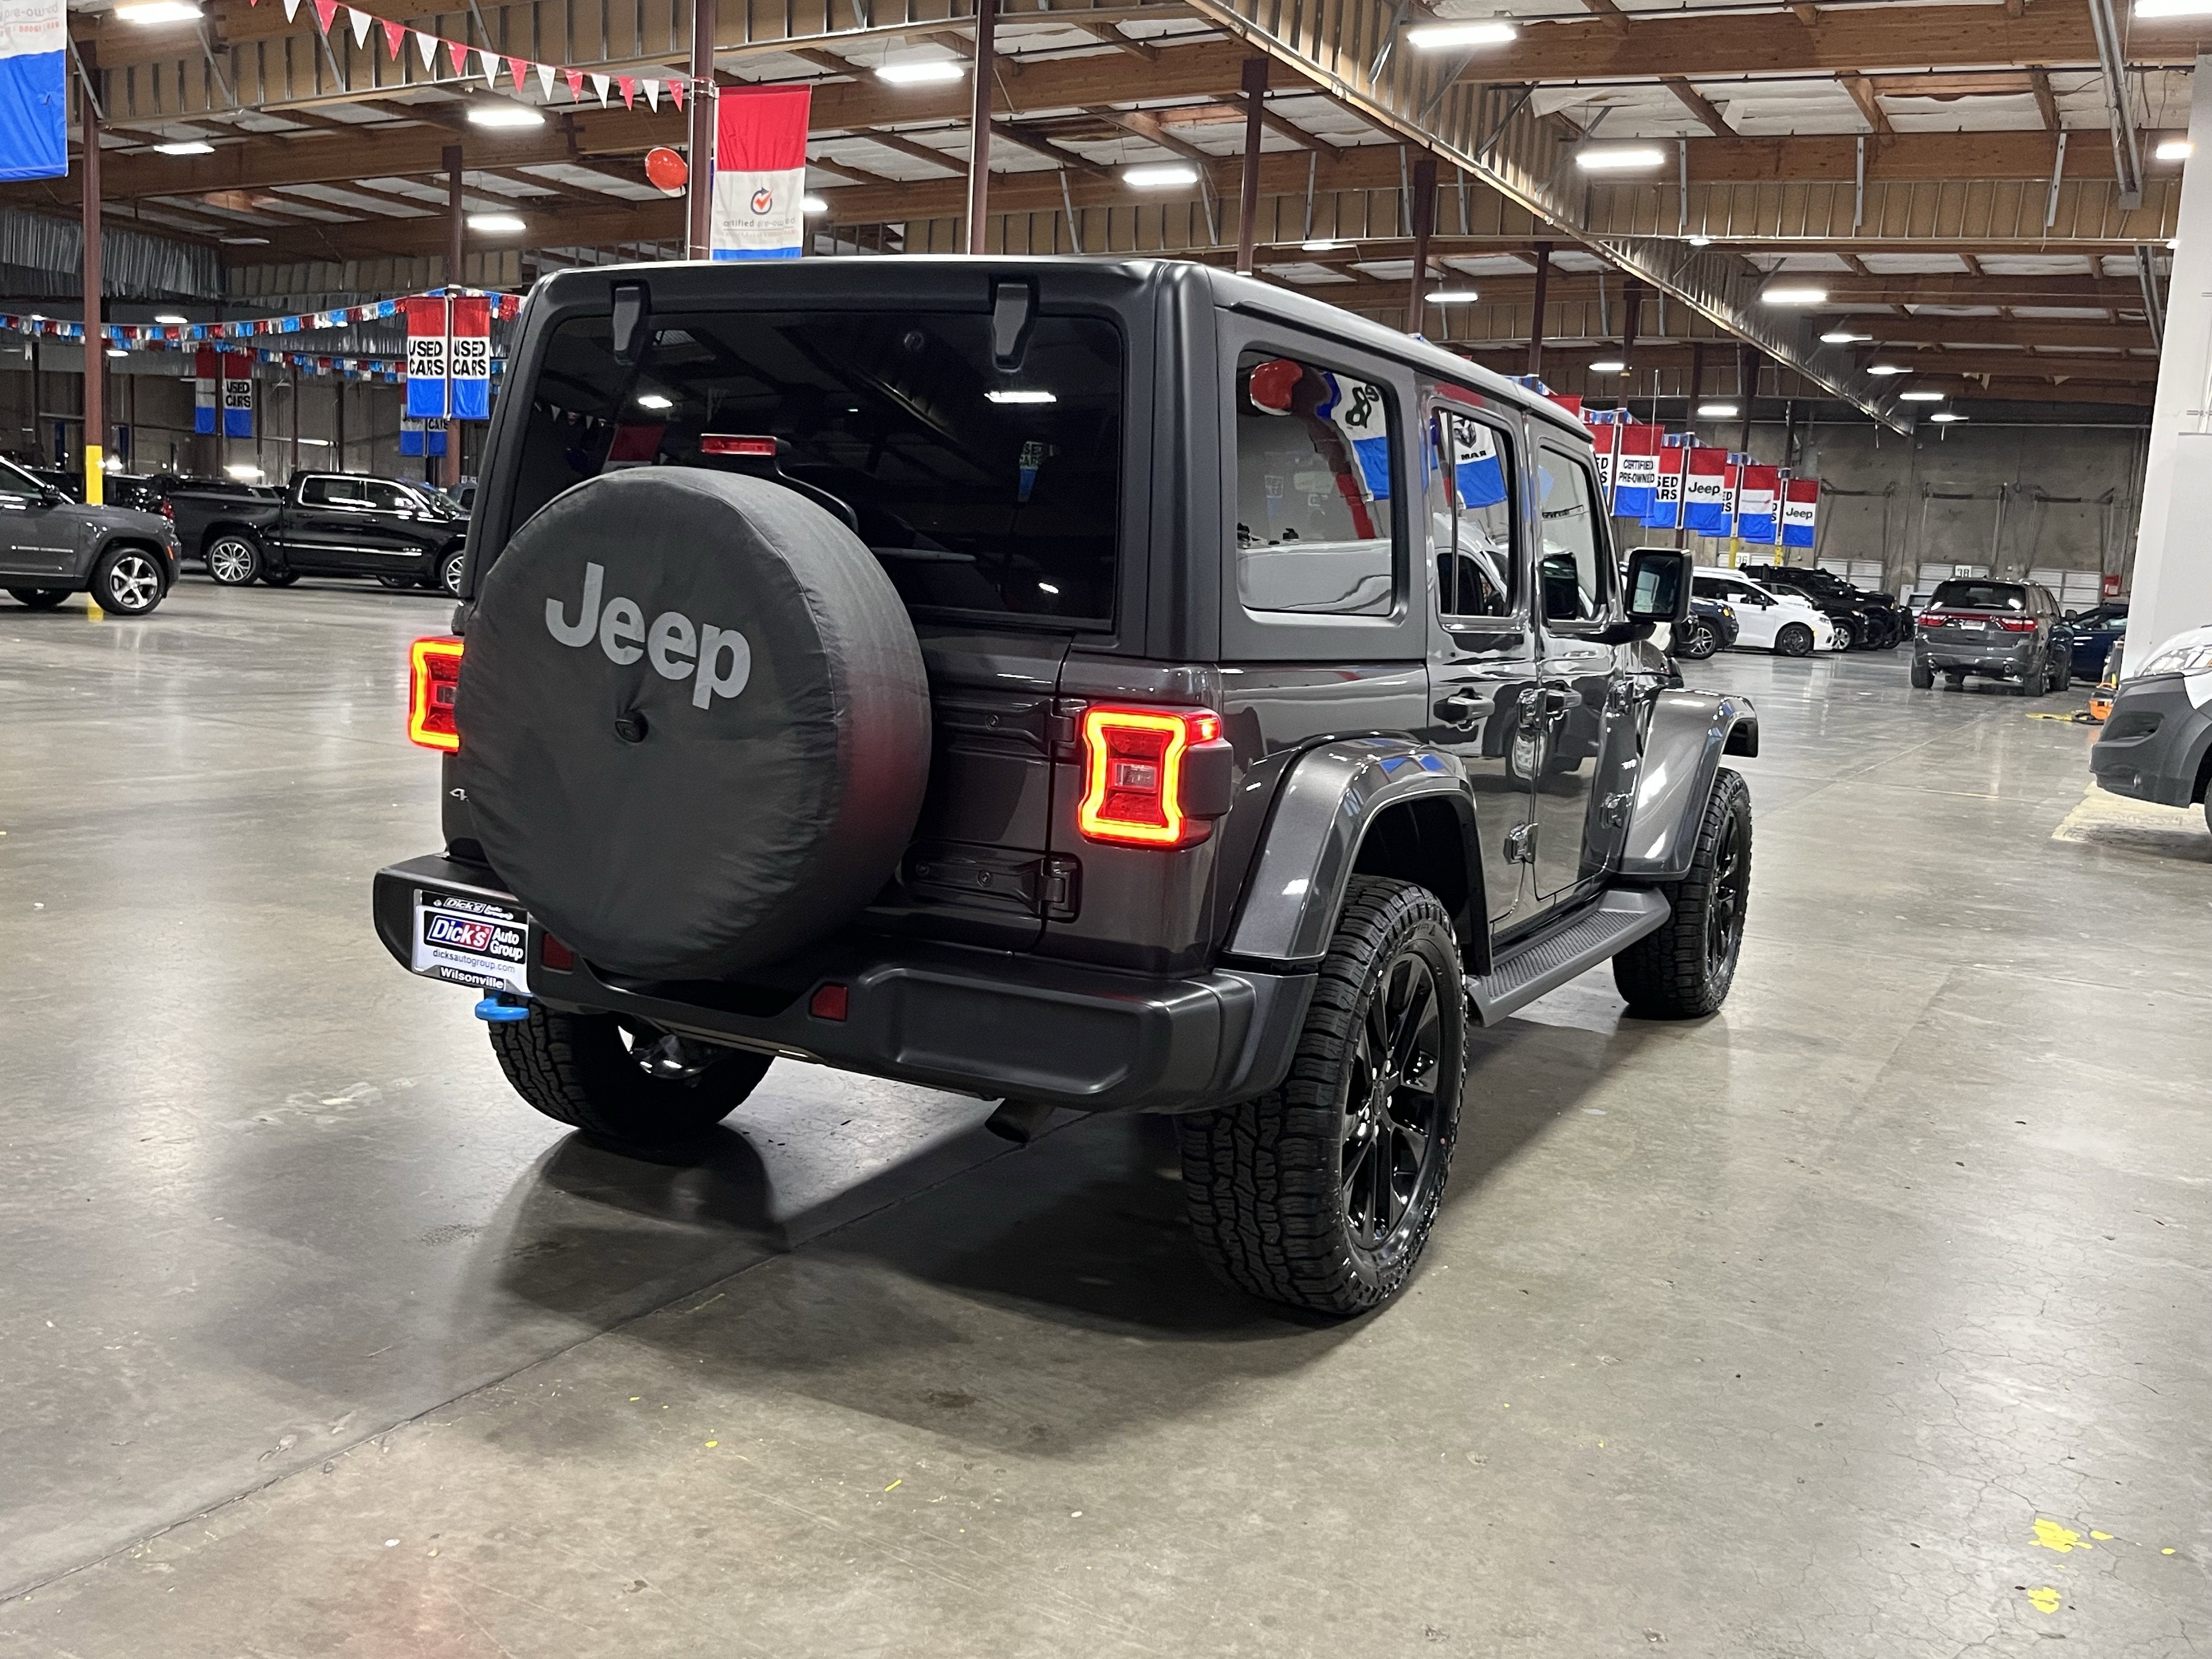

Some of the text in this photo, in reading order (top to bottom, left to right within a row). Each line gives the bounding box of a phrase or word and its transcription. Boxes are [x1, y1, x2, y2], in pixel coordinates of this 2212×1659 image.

[4, 1, 58, 19] pre-owed
[758, 217, 795, 227] pre-owed
[409, 340, 443, 357] USED
[454, 340, 486, 357] USED
[409, 359, 444, 375] CARS
[453, 359, 486, 376] CARS
[227, 381, 250, 393] USED
[226, 395, 250, 408] CARS
[1618, 472, 1655, 483] PRE-OWNED
[1688, 482, 1720, 496] Jeep
[1786, 507, 1813, 520] Jeep
[545, 562, 751, 710] Jeep
[447, 899, 483, 912] Dick's
[432, 919, 488, 947] Dick's
[492, 927, 520, 945] Auto
[490, 940, 523, 961] Group
[433, 949, 515, 973] dicksautogroup.com
[441, 967, 504, 989] Wilsonville
